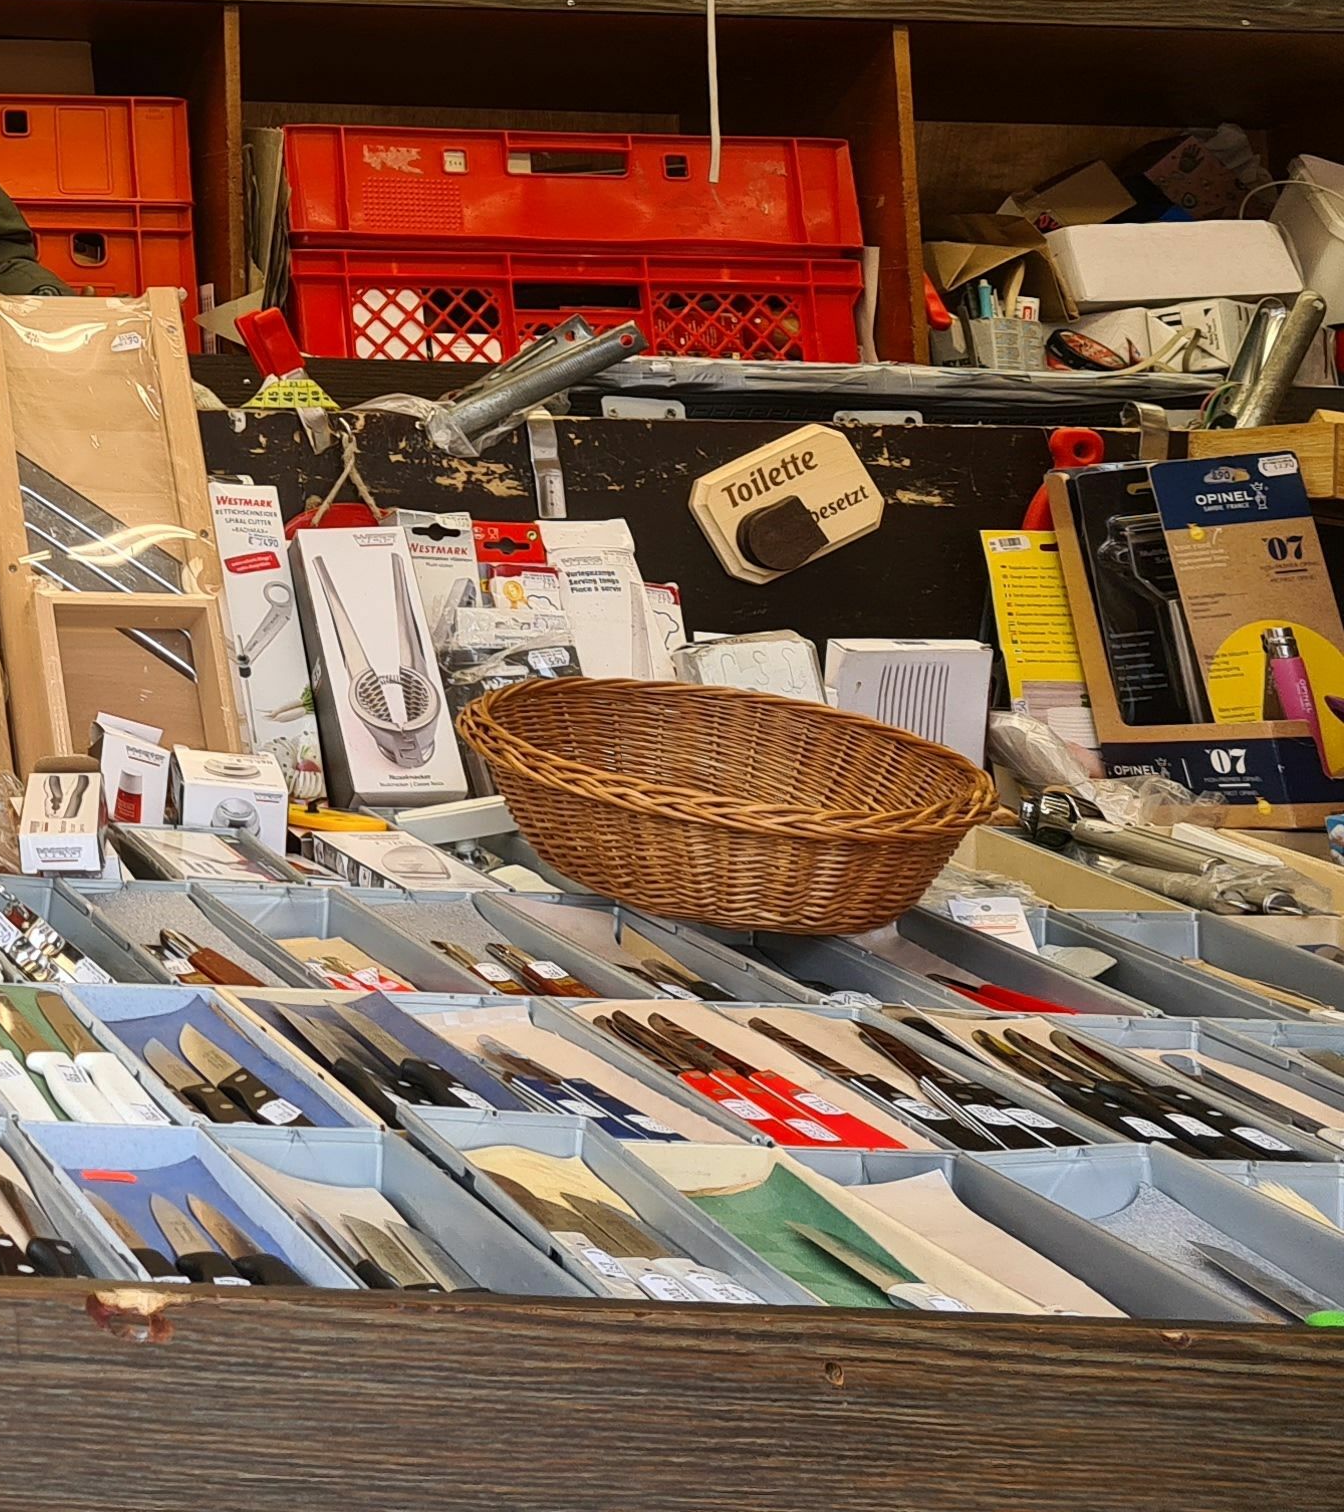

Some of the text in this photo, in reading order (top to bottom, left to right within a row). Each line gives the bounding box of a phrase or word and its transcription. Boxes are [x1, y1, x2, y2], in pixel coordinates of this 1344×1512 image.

[721, 450, 819, 509] Toilette
[216, 496, 273, 508] WESTMARK
[1195, 490, 1254, 506] OPINEL
[1113, 764, 1160, 777] OPINEL
